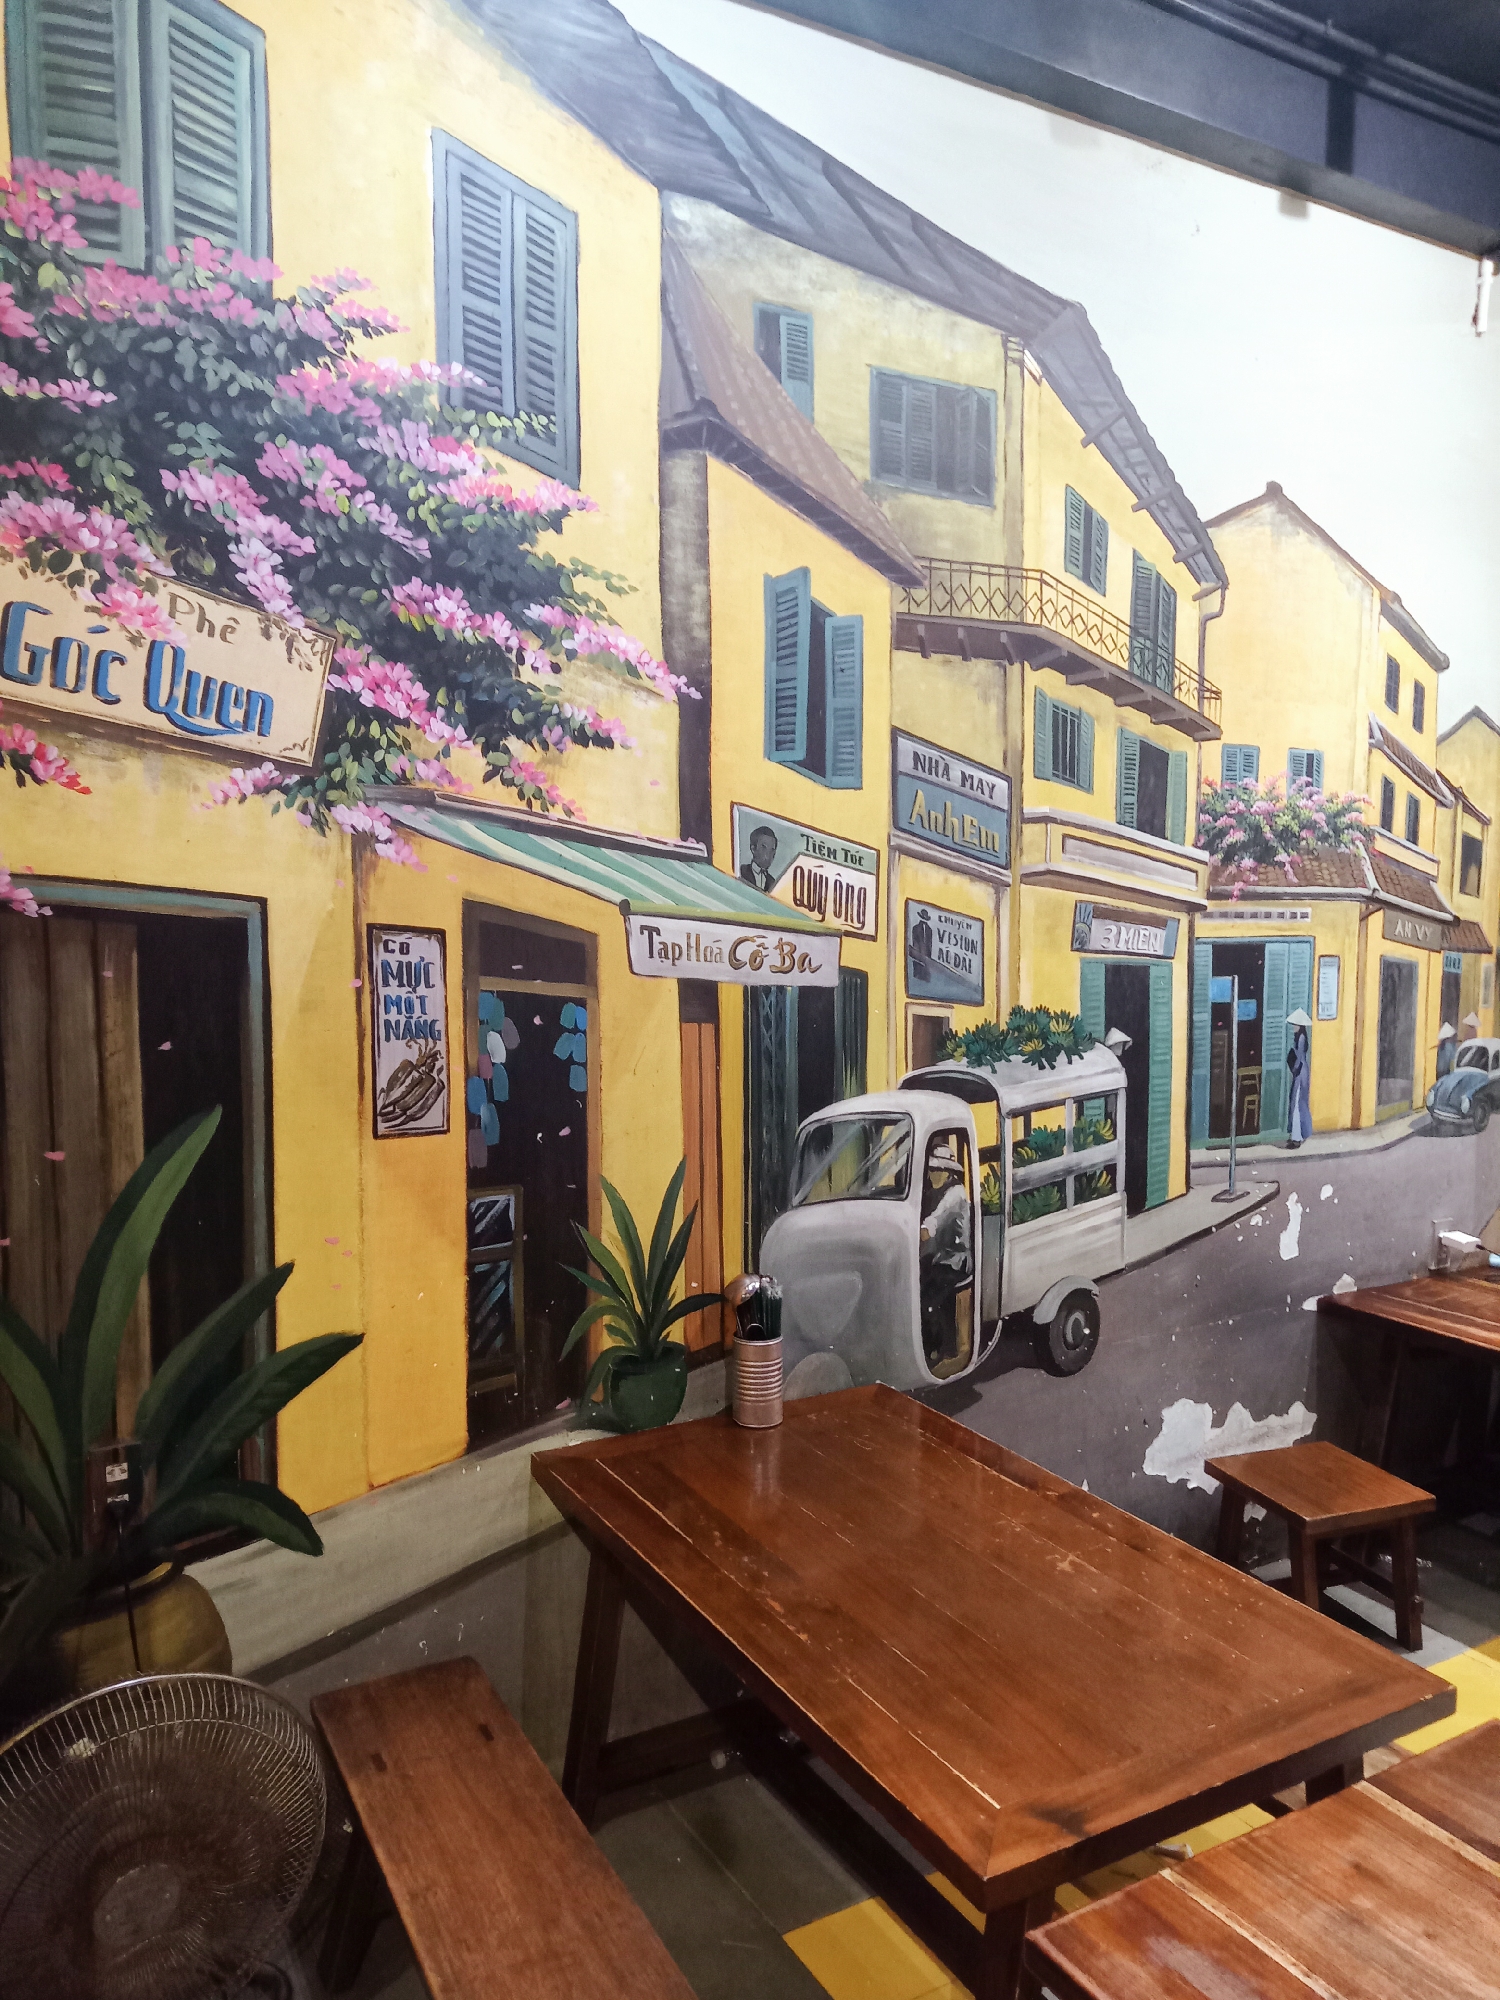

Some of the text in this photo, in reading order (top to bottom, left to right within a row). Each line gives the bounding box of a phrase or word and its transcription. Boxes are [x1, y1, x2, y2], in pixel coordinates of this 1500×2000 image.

[168, 591, 241, 644] Phê
[0, 601, 128, 705] Góc
[912, 751, 997, 800] NHÀ MAY
[908, 789, 1000, 853] Anh Em
[382, 936, 413, 956] CÓ
[1100, 924, 1118, 950] 3
[1393, 919, 1433, 942] AN VY
[380, 955, 436, 994] MỰC
[769, 936, 823, 975] Ba
[953, 952, 973, 975] DÀI
[383, 1013, 442, 1043] NẮNG
